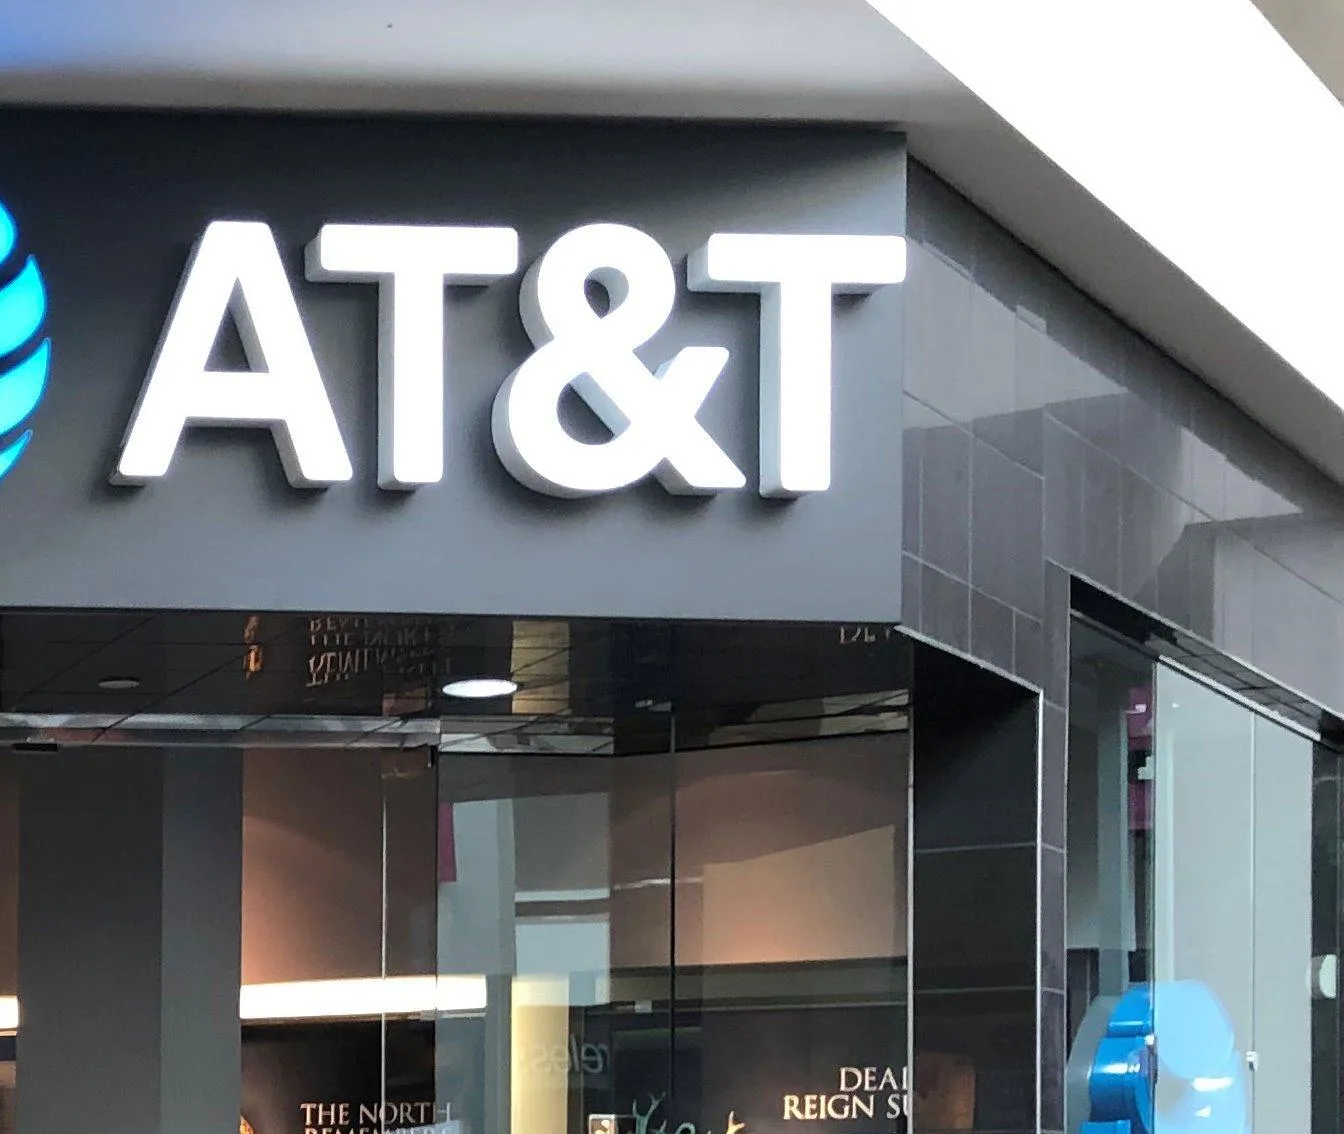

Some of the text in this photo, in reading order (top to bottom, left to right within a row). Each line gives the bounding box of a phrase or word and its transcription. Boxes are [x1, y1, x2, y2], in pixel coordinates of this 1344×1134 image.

[113, 220, 907, 498] AT&T
[300, 1102, 452, 1126] THE NORTH
[783, 1094, 874, 1120] REIGN
